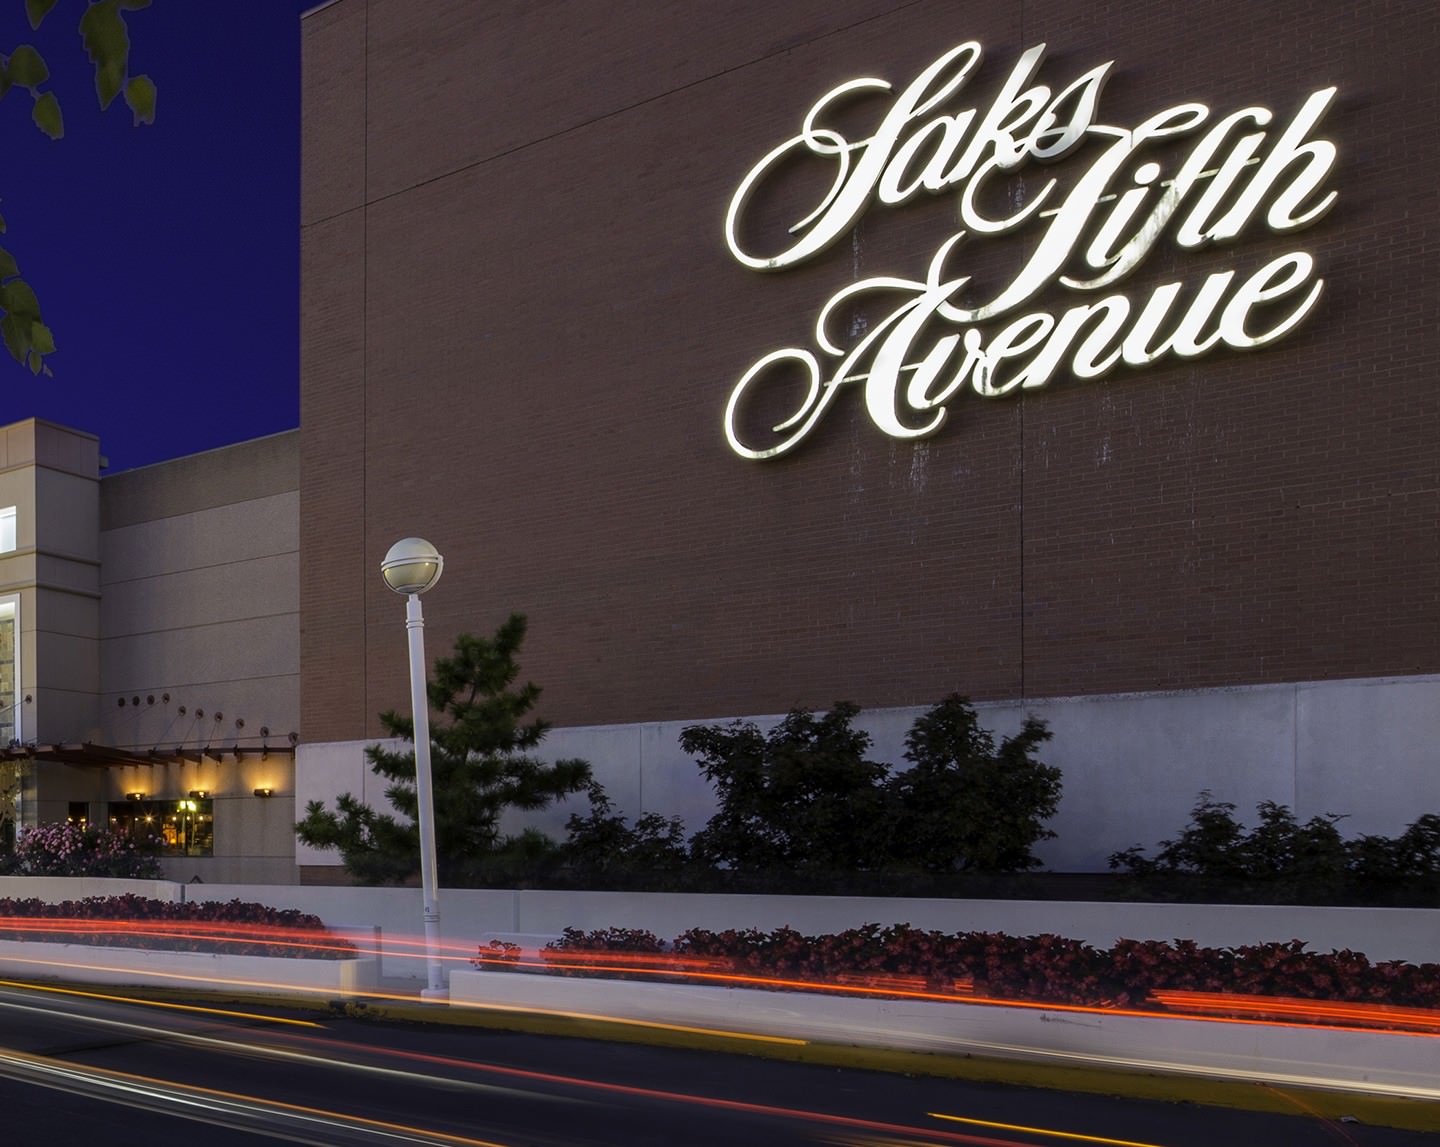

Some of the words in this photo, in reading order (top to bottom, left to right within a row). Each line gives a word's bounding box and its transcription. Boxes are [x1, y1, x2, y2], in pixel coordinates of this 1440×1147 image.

[725, 40, 1116, 270] Saks
[926, 86, 1338, 322] Fifth
[724, 251, 1325, 460] Avenue
